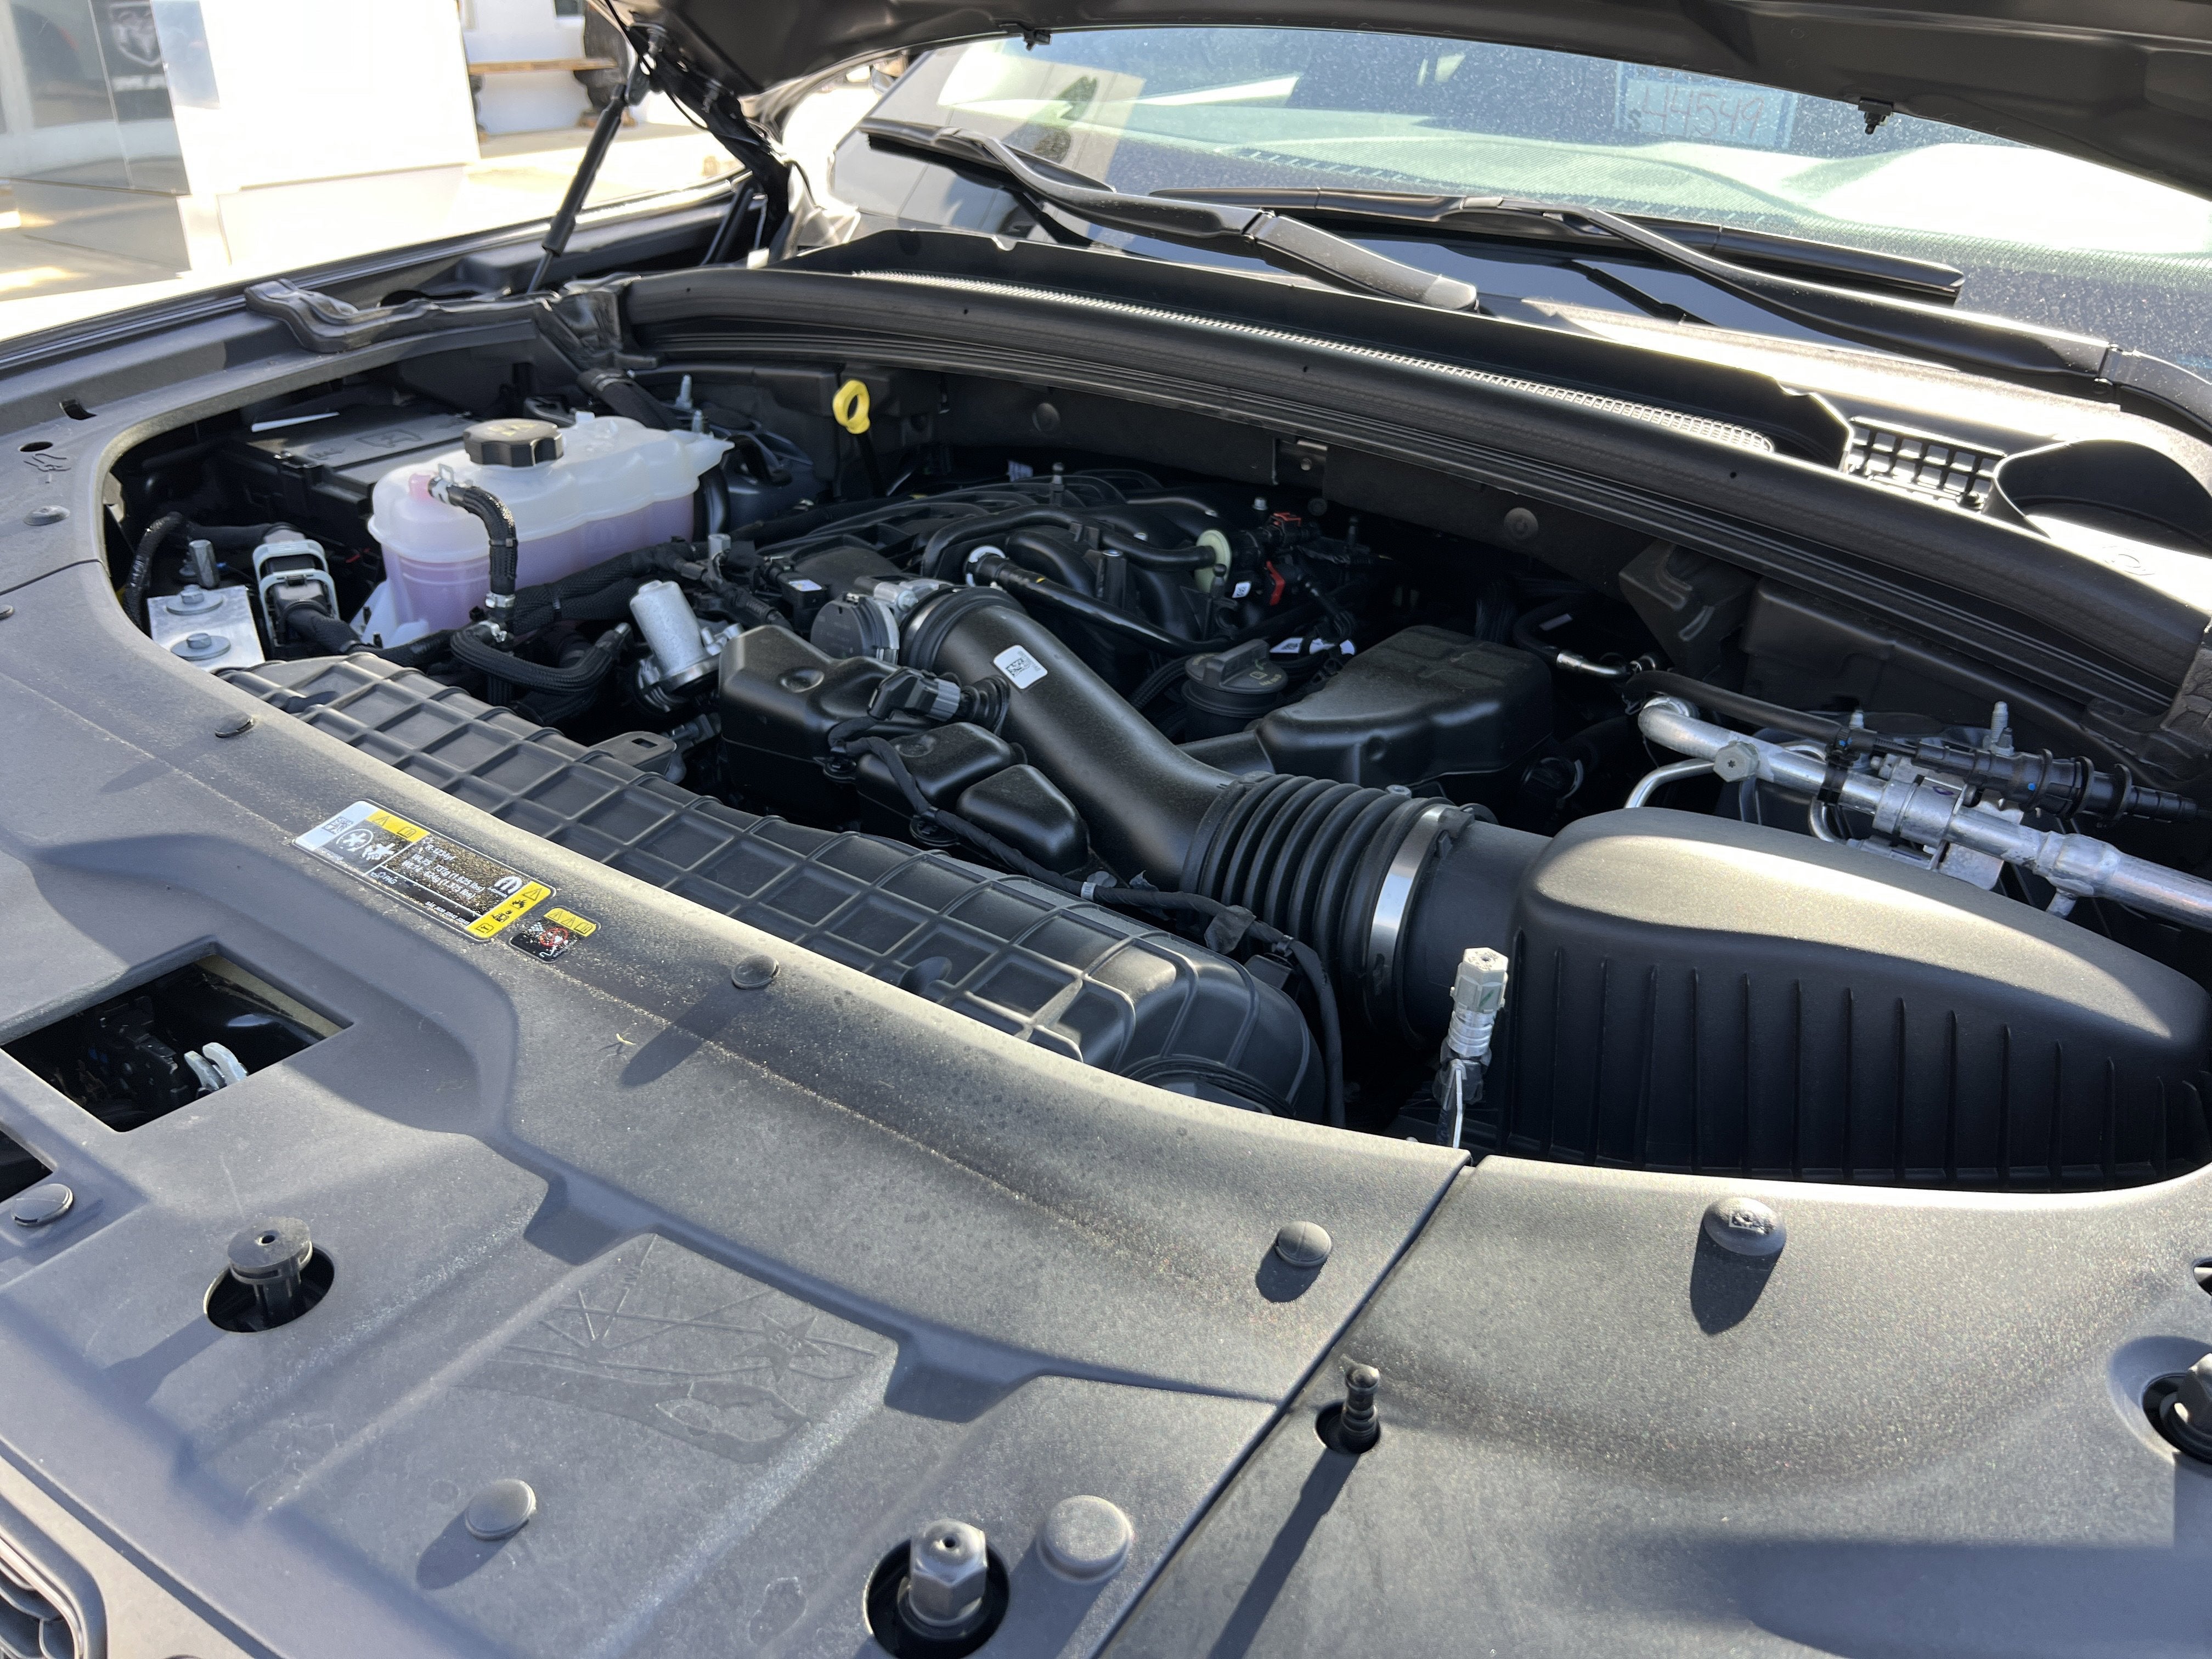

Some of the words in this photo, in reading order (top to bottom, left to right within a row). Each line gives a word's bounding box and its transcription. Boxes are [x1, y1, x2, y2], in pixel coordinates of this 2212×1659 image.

[1641, 85, 1765, 139] 44549
[425, 844, 456, 861] R-1234yf
[383, 876, 398, 884] PAG
[401, 860, 423, 872] WL74
[424, 871, 441, 883] 624g
[437, 879, 463, 893] (1.375
[459, 888, 476, 900] lbs)
[411, 853, 432, 866] WL75
[448, 872, 472, 885] (1.625
[470, 881, 486, 893] lbs)
